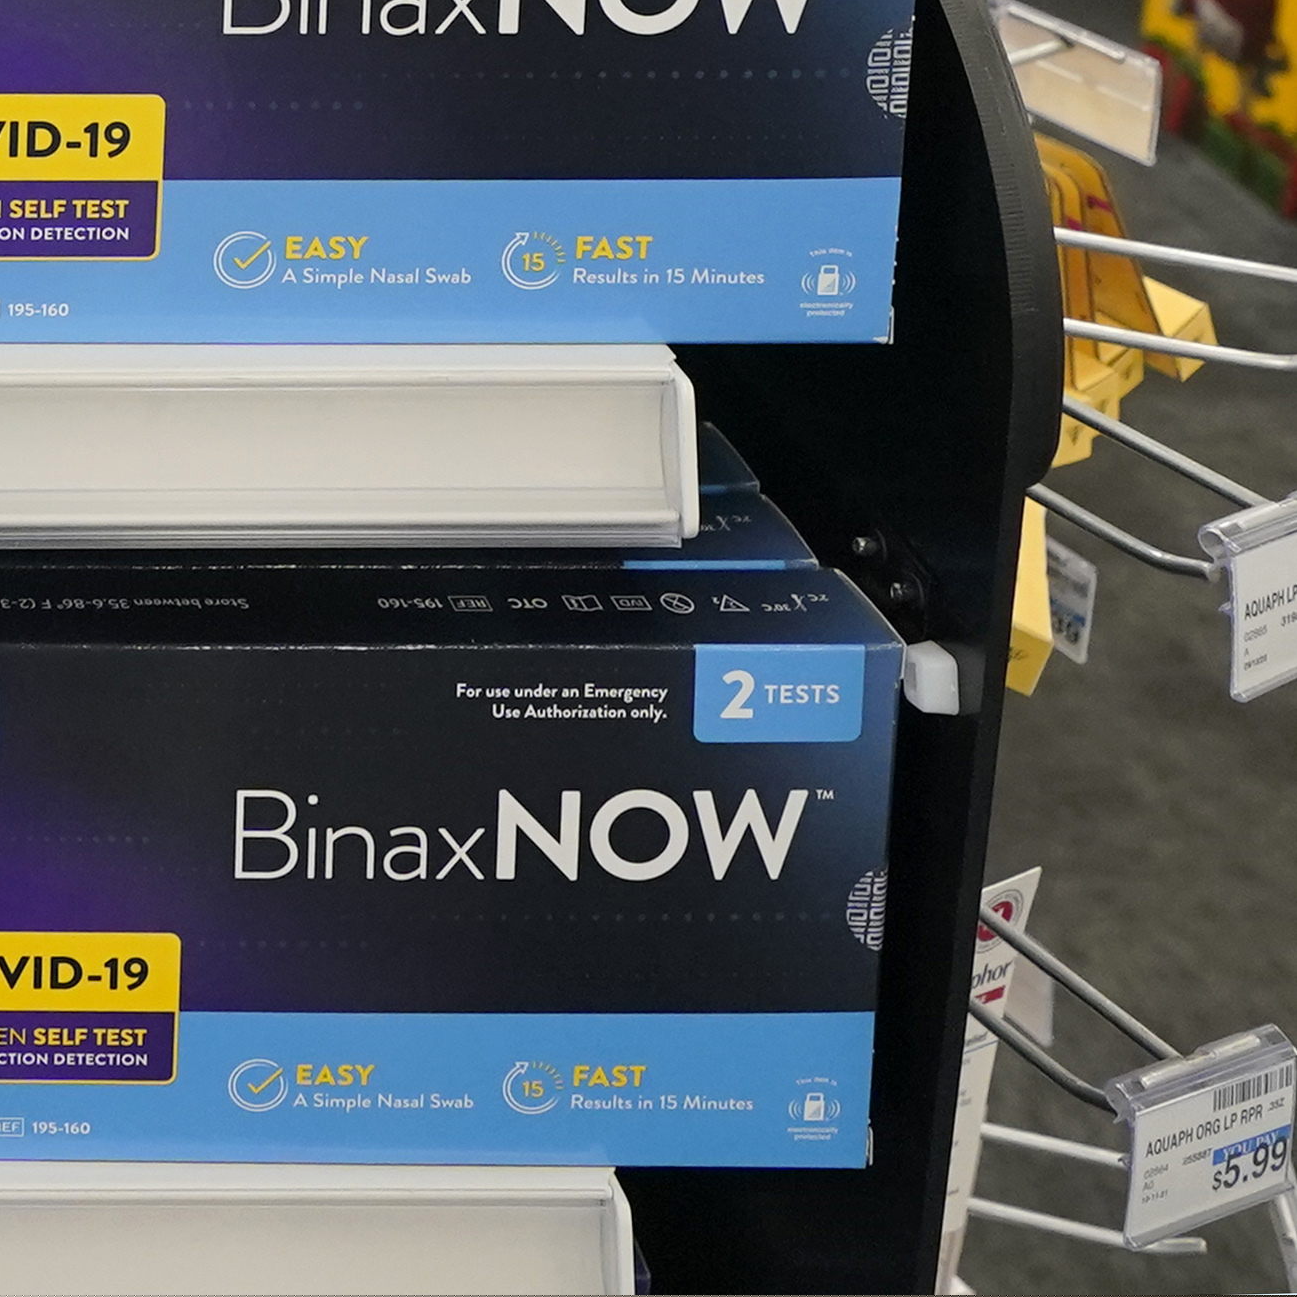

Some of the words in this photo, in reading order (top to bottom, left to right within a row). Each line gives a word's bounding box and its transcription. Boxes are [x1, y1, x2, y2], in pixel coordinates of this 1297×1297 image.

[9, 200, 67, 218] SELF
[73, 200, 129, 218] TEST
[31, 227, 129, 241] DETECTION
[285, 236, 369, 260] EASY
[576, 236, 652, 260] FAST
[1245, 588, 1284, 620] AQUAPH
[720, 670, 755, 719] 2
[765, 684, 839, 704] TESTS
[33, 1029, 87, 1046] SELF
[94, 1029, 147, 1046] TEST
[296, 1065, 375, 1085] EASY
[573, 1066, 646, 1087] FAST
[32, 1121, 90, 1134] 195-160
[1146, 1128, 1193, 1158] AQUAPH
[1196, 1119, 1220, 1140] ORG
[1224, 1113, 1237, 1131] LP
[1240, 1104, 1263, 1125] RPR
[1222, 1143, 1253, 1160] YOU
[1256, 1130, 1279, 1148] PAY
[1212, 1137, 1287, 1191] $5.99
